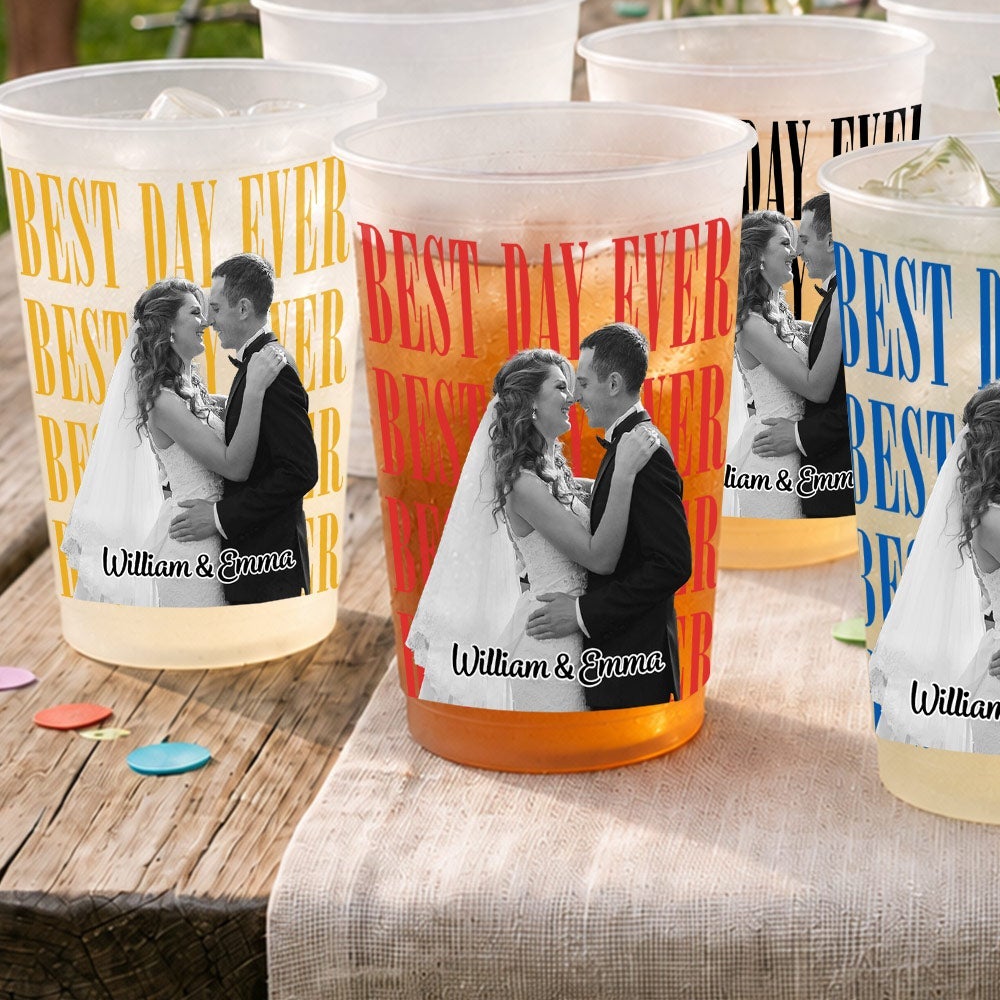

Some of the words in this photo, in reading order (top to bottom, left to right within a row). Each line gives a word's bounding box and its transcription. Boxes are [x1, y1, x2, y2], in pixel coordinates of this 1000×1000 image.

[8, 167, 118, 289] BEST
[140, 180, 217, 288] DAY
[240, 156, 348, 278] EVER
[358, 222, 478, 358] BEST
[501, 241, 588, 360] DAY
[612, 217, 731, 350] EVER
[833, 241, 951, 386] BEST
[724, 464, 773, 490] liam
[776, 469, 793, 492] &
[795, 465, 855, 498] Emm
[102, 545, 192, 578] William
[195, 553, 215, 578] &
[217, 548, 296, 584] Emma
[452, 642, 550, 679] William
[554, 653, 575, 680] &
[578, 648, 666, 687] Emma
